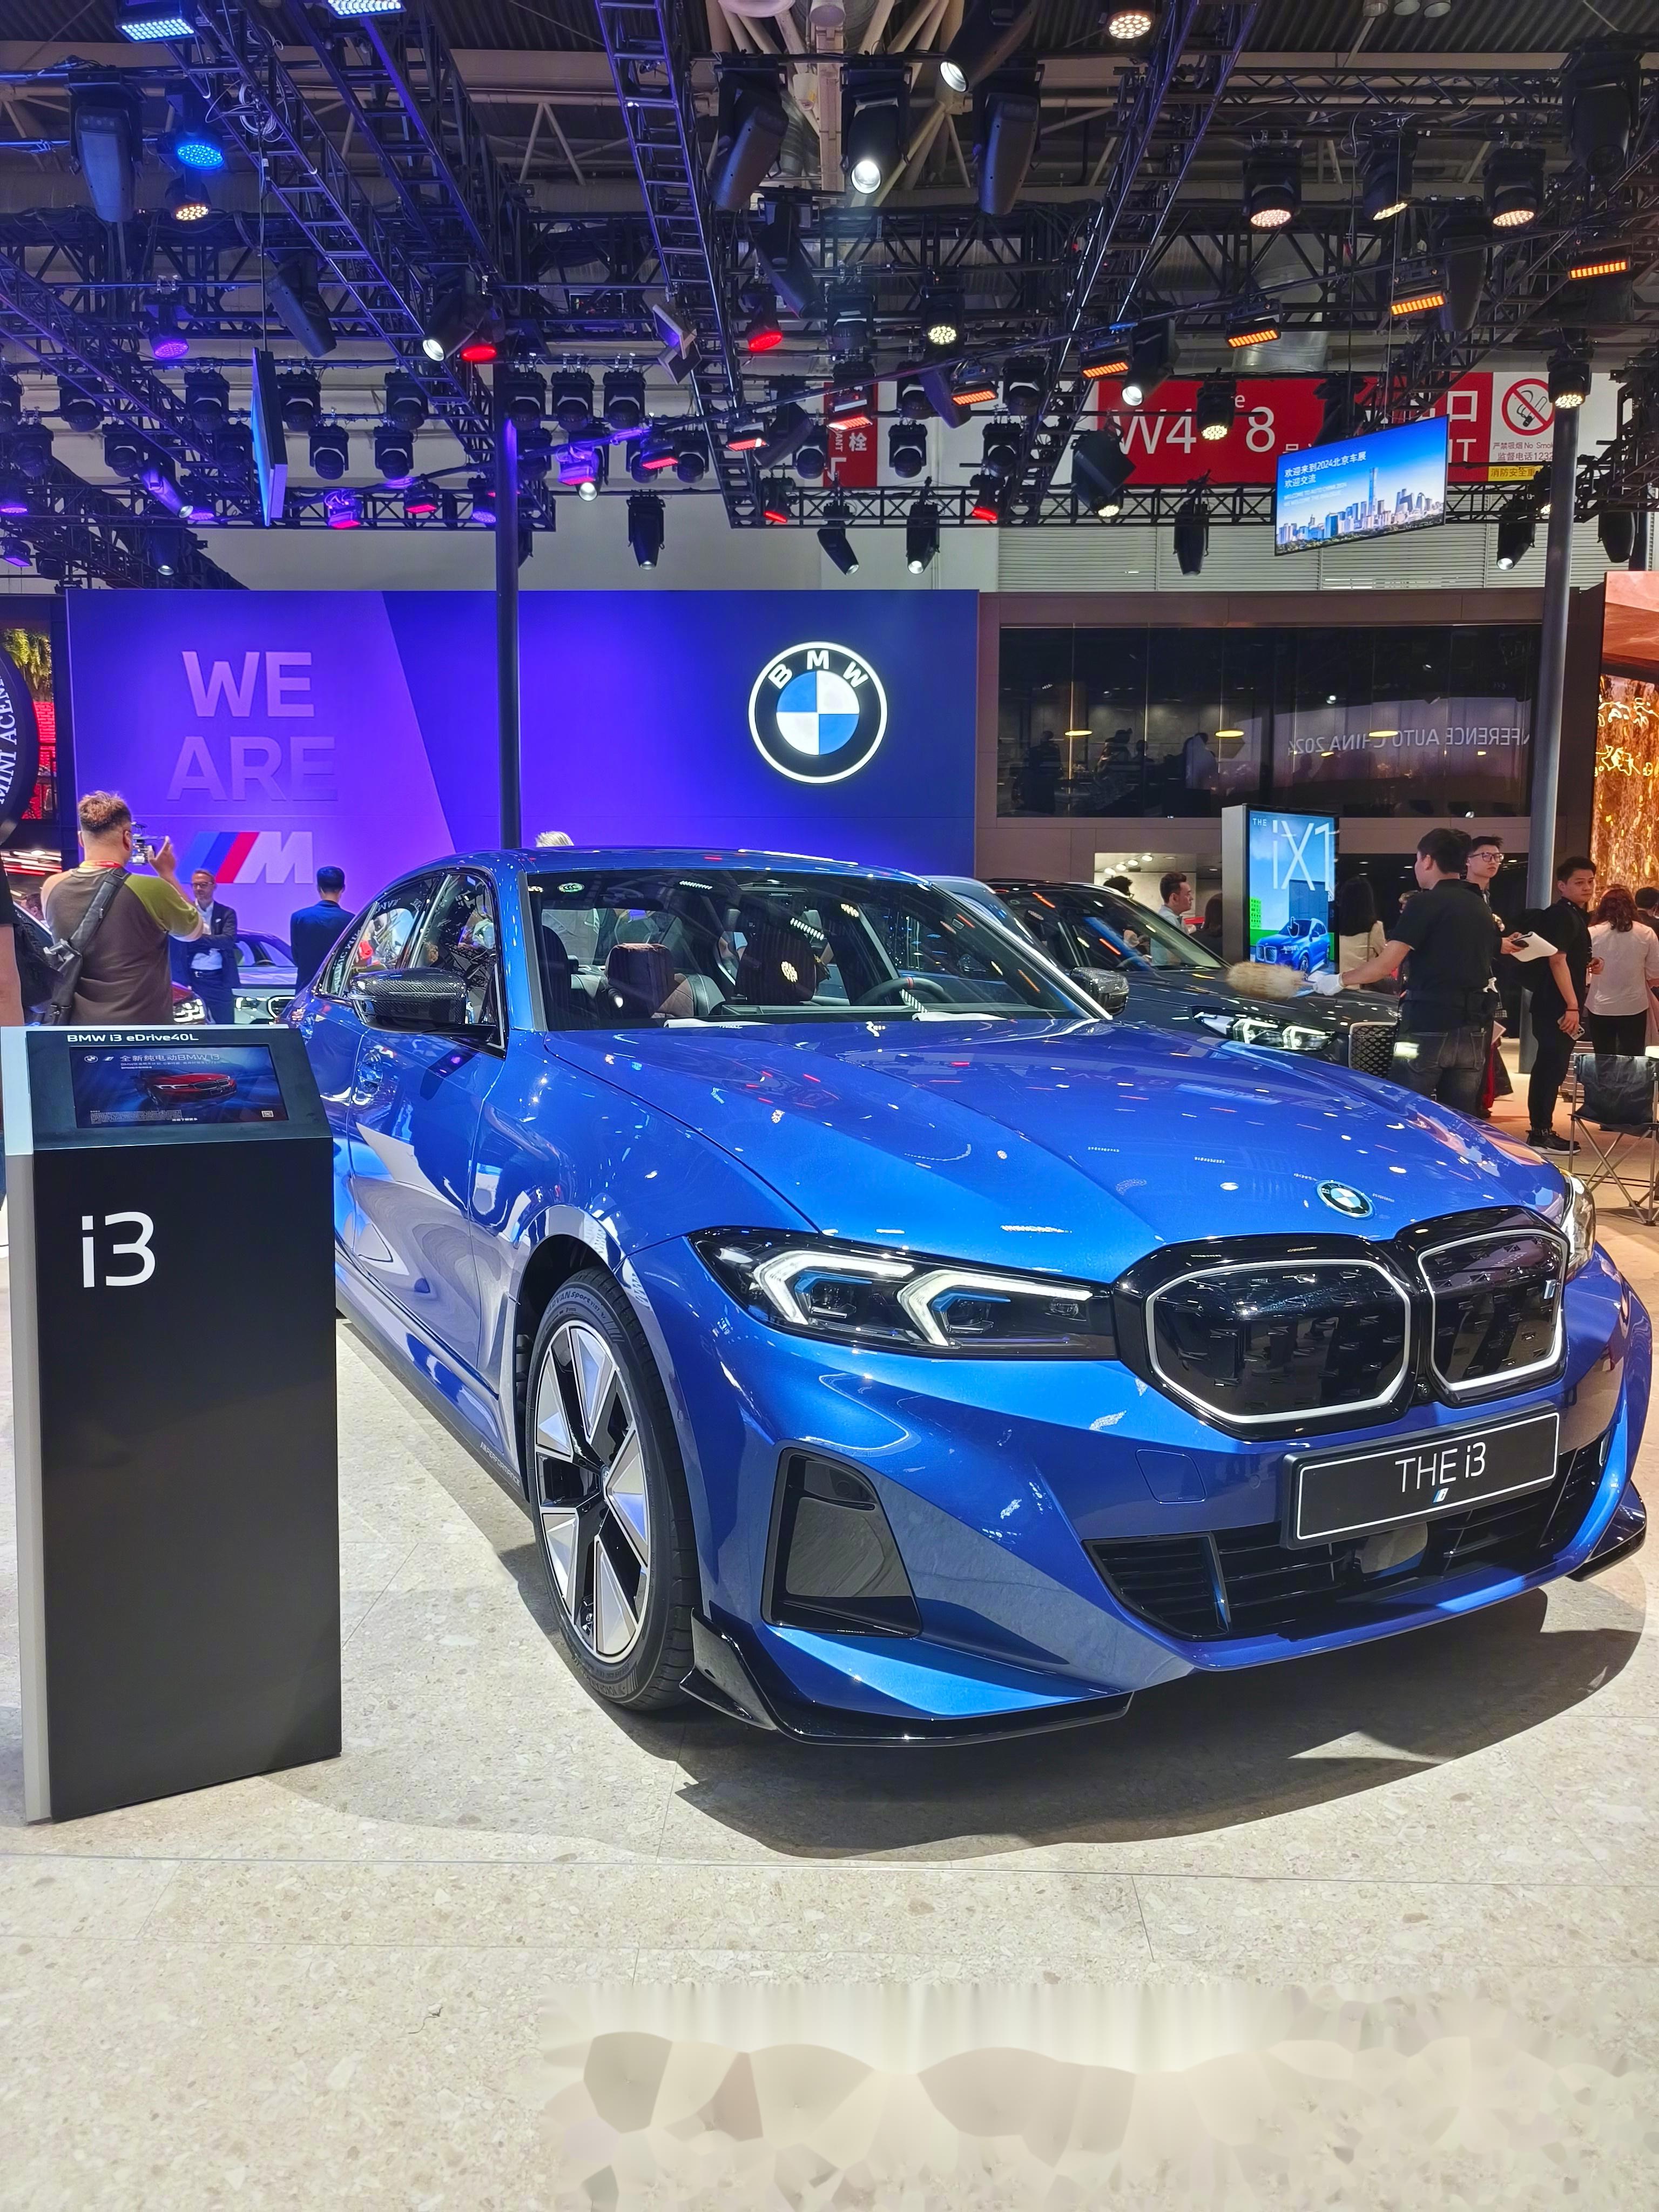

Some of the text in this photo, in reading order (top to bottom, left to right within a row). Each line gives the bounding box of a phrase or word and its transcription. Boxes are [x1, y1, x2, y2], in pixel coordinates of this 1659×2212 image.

[1112, 409, 1196, 454] W4
[1285, 451, 1366, 478] 欢迎来到2024北京车展
[1285, 474, 1316, 488] 欢迎交流
[1491, 468, 1535, 477] 消防安全重
[183, 651, 314, 717] WE
[767, 650, 869, 689] BMW
[167, 736, 339, 801] ARE
[1252, 818, 1330, 892] THE iX1
[67, 1034, 105, 1042] BMW
[126, 1033, 199, 1042] eDrive40L
[81, 1211, 156, 1288] i3
[1395, 1442, 1486, 1493] THE i3
